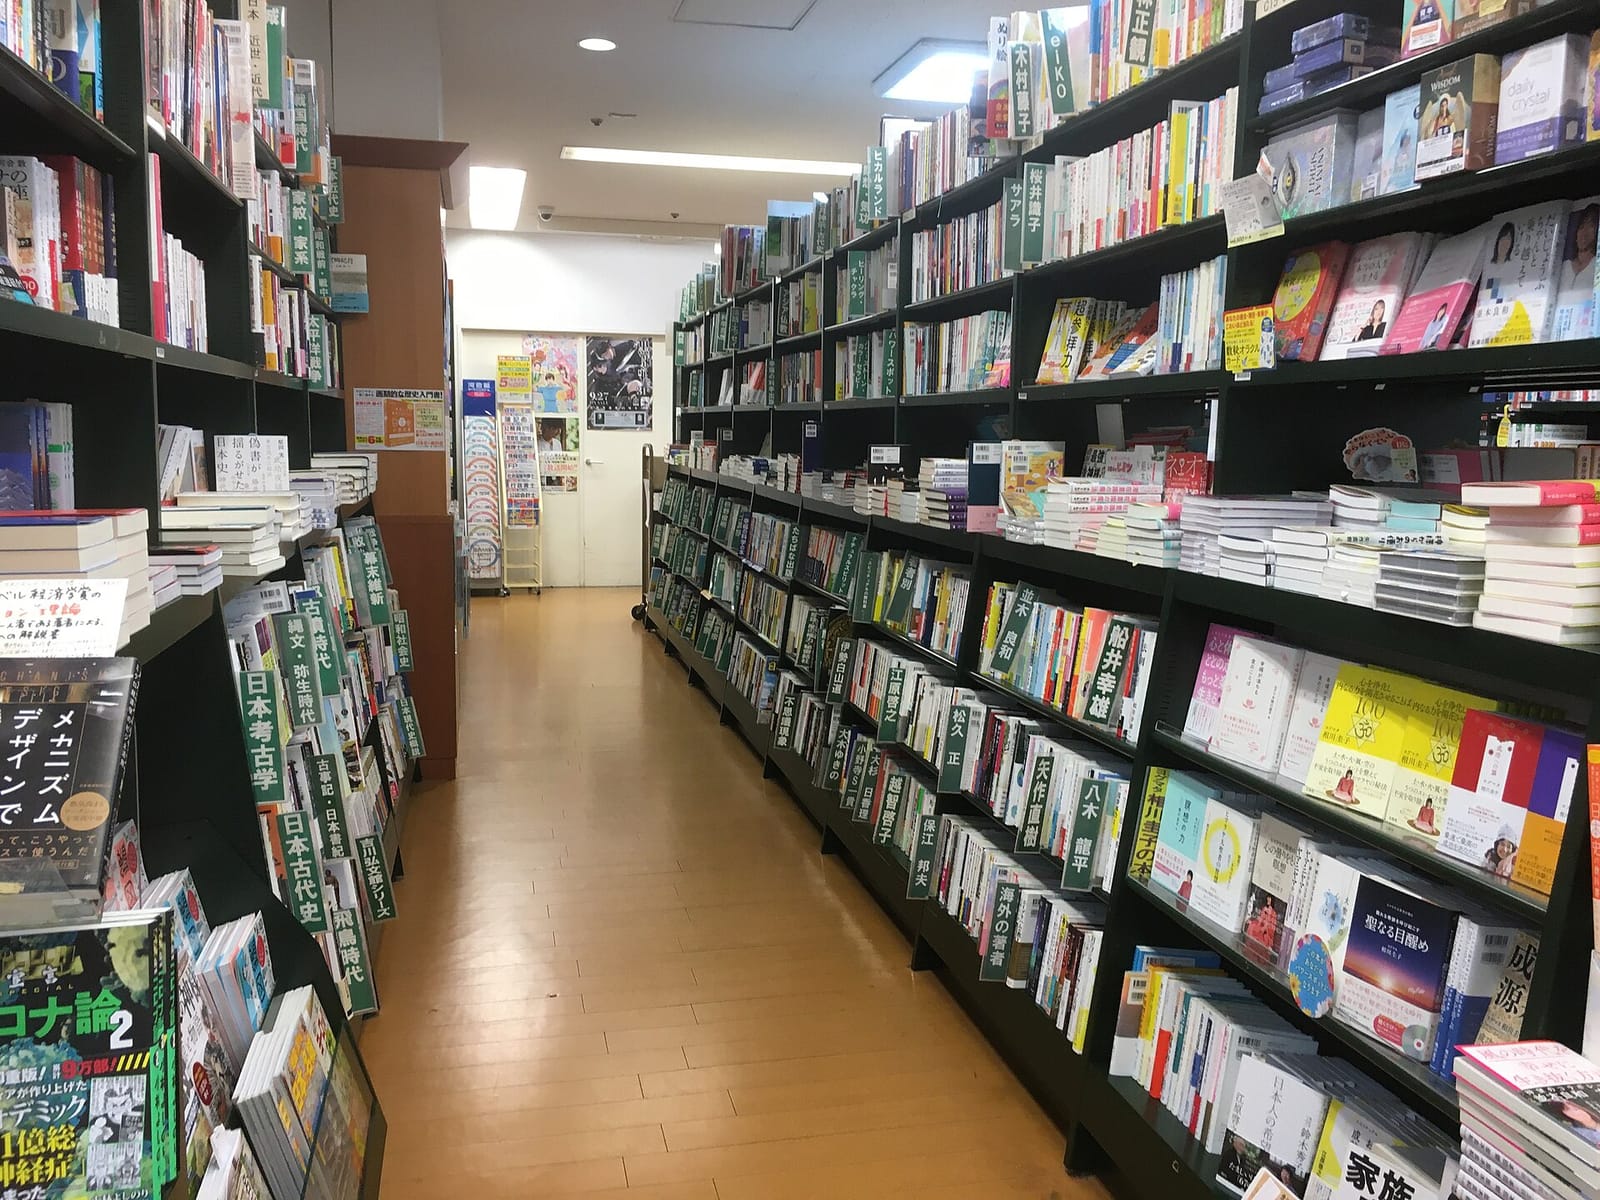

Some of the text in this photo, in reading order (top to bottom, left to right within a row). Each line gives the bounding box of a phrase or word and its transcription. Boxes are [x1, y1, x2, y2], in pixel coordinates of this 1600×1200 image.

[1430, 75, 1461, 92] WISDOM
[1507, 78, 1535, 98] daily
[1511, 88, 1551, 112] crystal
[873, 150, 883, 217] ヒカルランド
[1009, 184, 1022, 228] サアラ
[1027, 168, 1044, 233] 桜井識子
[292, 190, 309, 265] 家紋・家系
[308, 315, 323, 383] 太平洋戦争
[885, 330, 897, 395] パワースポット
[375, 390, 443, 399] 画期的な歴史入門書!
[216, 437, 229, 474] 日本史
[232, 437, 246, 490] 揺るがせた
[249, 437, 262, 473] 偽書が
[363, 551, 384, 606] 幕末維新
[393, 612, 411, 668] 昭和社会史
[998, 587, 1036, 661] 並木 良和
[287, 618, 316, 723] 縄文・弥生時代
[831, 641, 850, 695] 伊勢白山道
[884, 669, 904, 722] 江原啓之
[1089, 624, 1130, 719] 船井幸雄
[247, 673, 279, 791] 日本考古学
[776, 694, 795, 747] 不思議現象
[1354, 697, 1387, 720] 100
[829, 728, 848, 780] 大木ゆきの
[867, 751, 881, 776] 大杉
[946, 708, 966, 766] 松久 正
[0, 707, 43, 825] デザインで
[33, 710, 75, 825] メカニズム
[315, 758, 344, 858] 古事記・日本書紀
[878, 775, 904, 844] 越智啓子
[1023, 759, 1050, 848] 矢作直樹
[1081, 784, 1100, 820] 八木
[283, 813, 322, 924] 日本古代史
[914, 818, 937, 887] 保江 邦夫
[332, 910, 365, 985] 飛鳥時代
[988, 886, 1018, 967] 海外の著者
[1364, 913, 1430, 953] 聖なる目醒め
[0, 1066, 46, 1086] 重版!
[1, 1124, 77, 1158] 1億総
